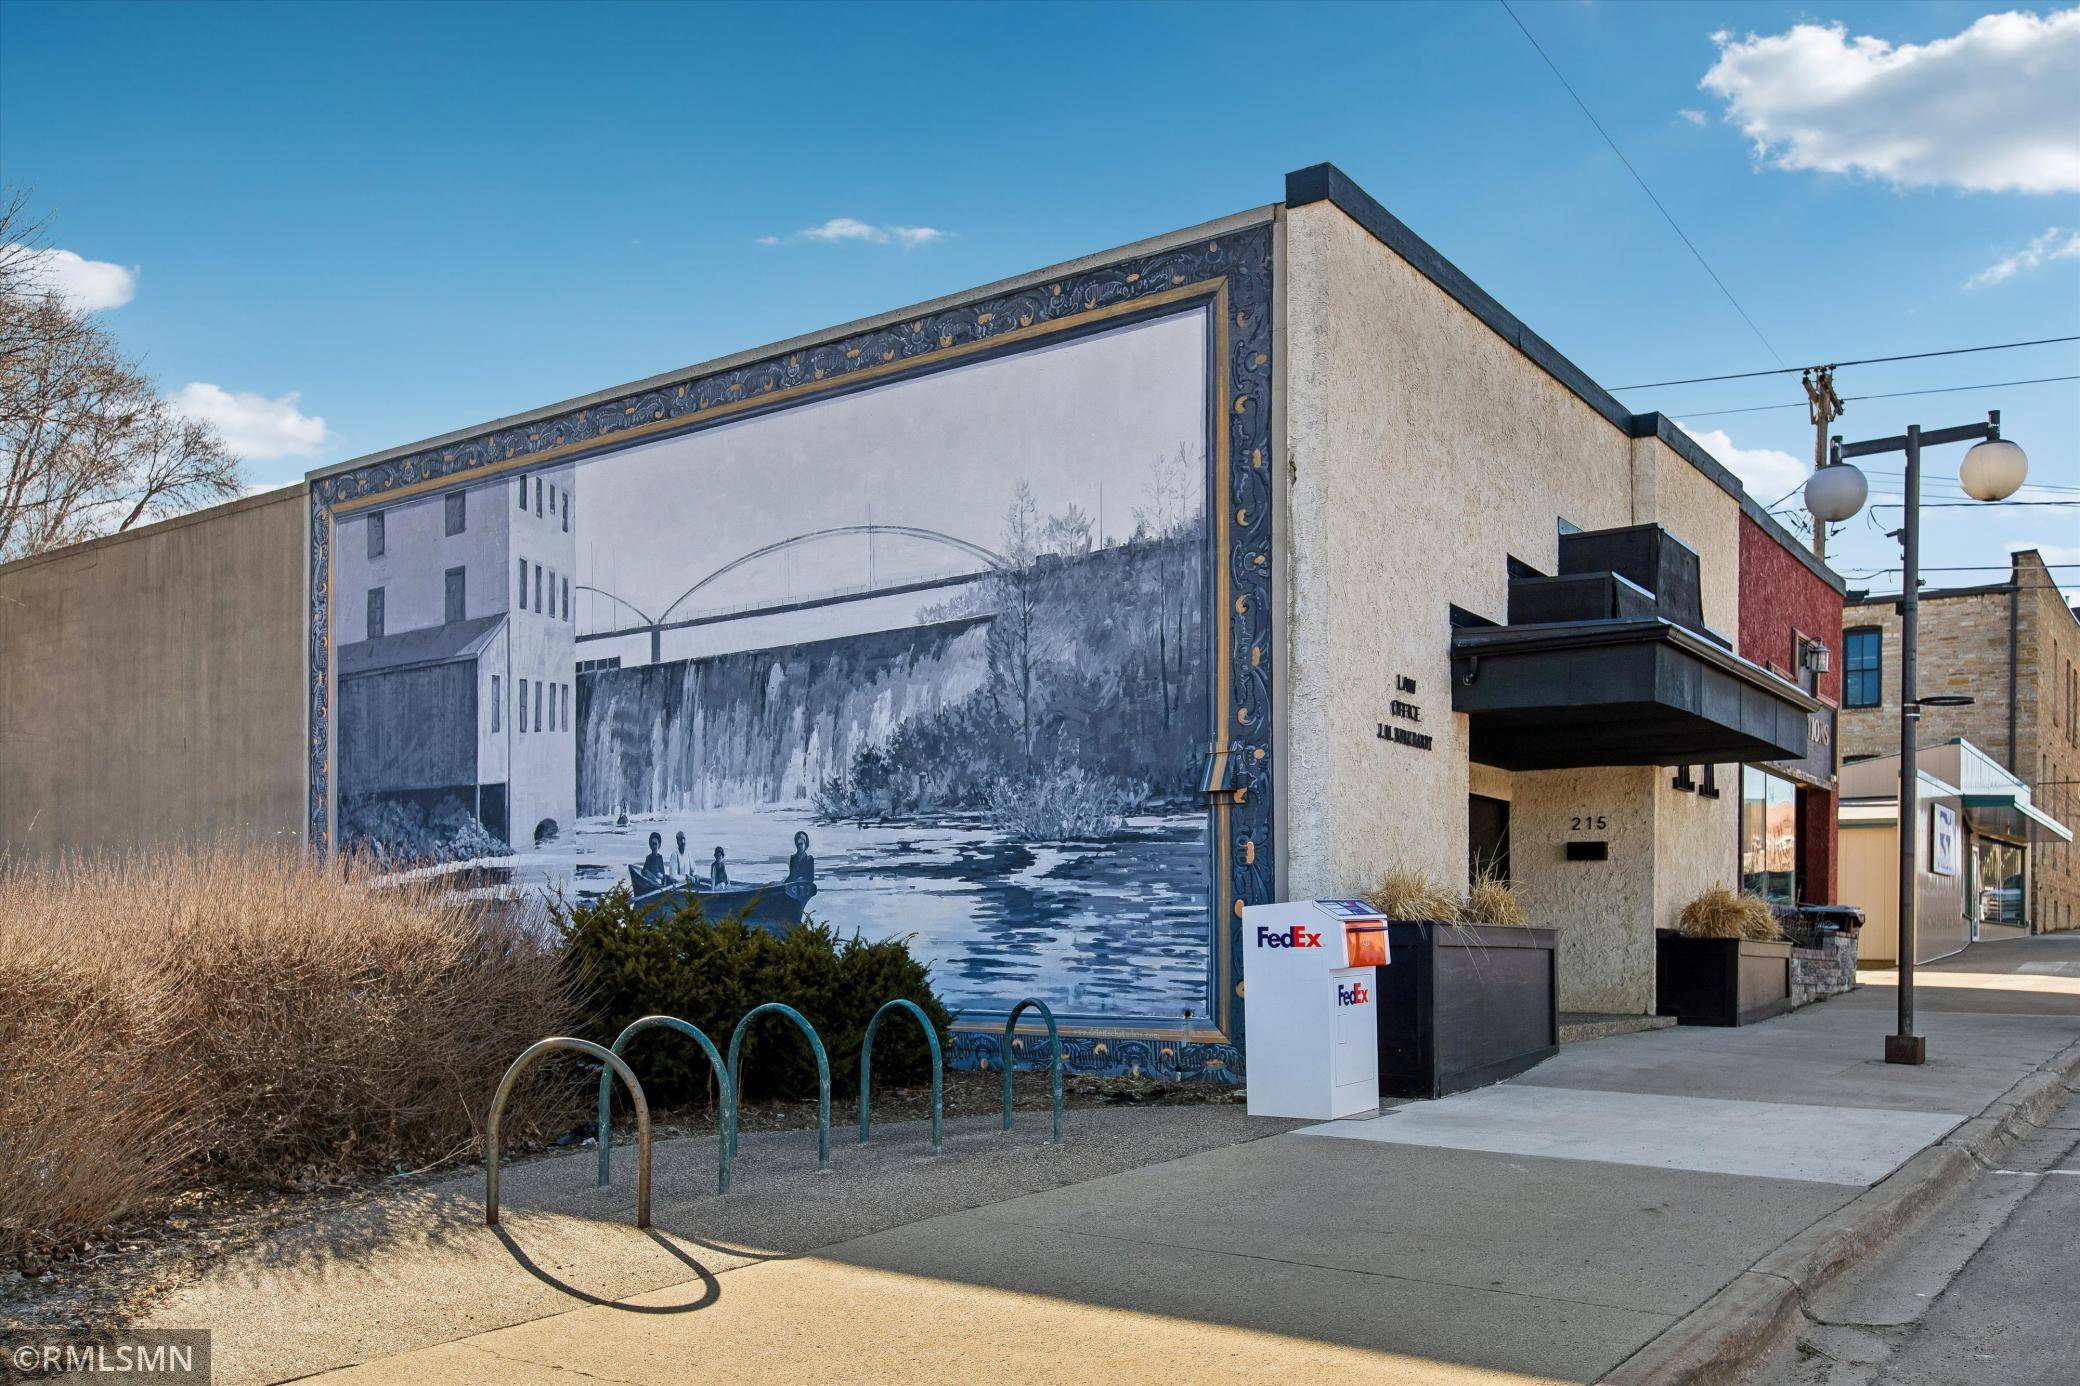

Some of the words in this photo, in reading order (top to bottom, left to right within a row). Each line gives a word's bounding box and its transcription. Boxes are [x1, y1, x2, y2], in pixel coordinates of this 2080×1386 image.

[1571, 816, 1607, 831] 215
[1257, 925, 1322, 948] FedEx
[1338, 982, 1369, 1007] FedEx
